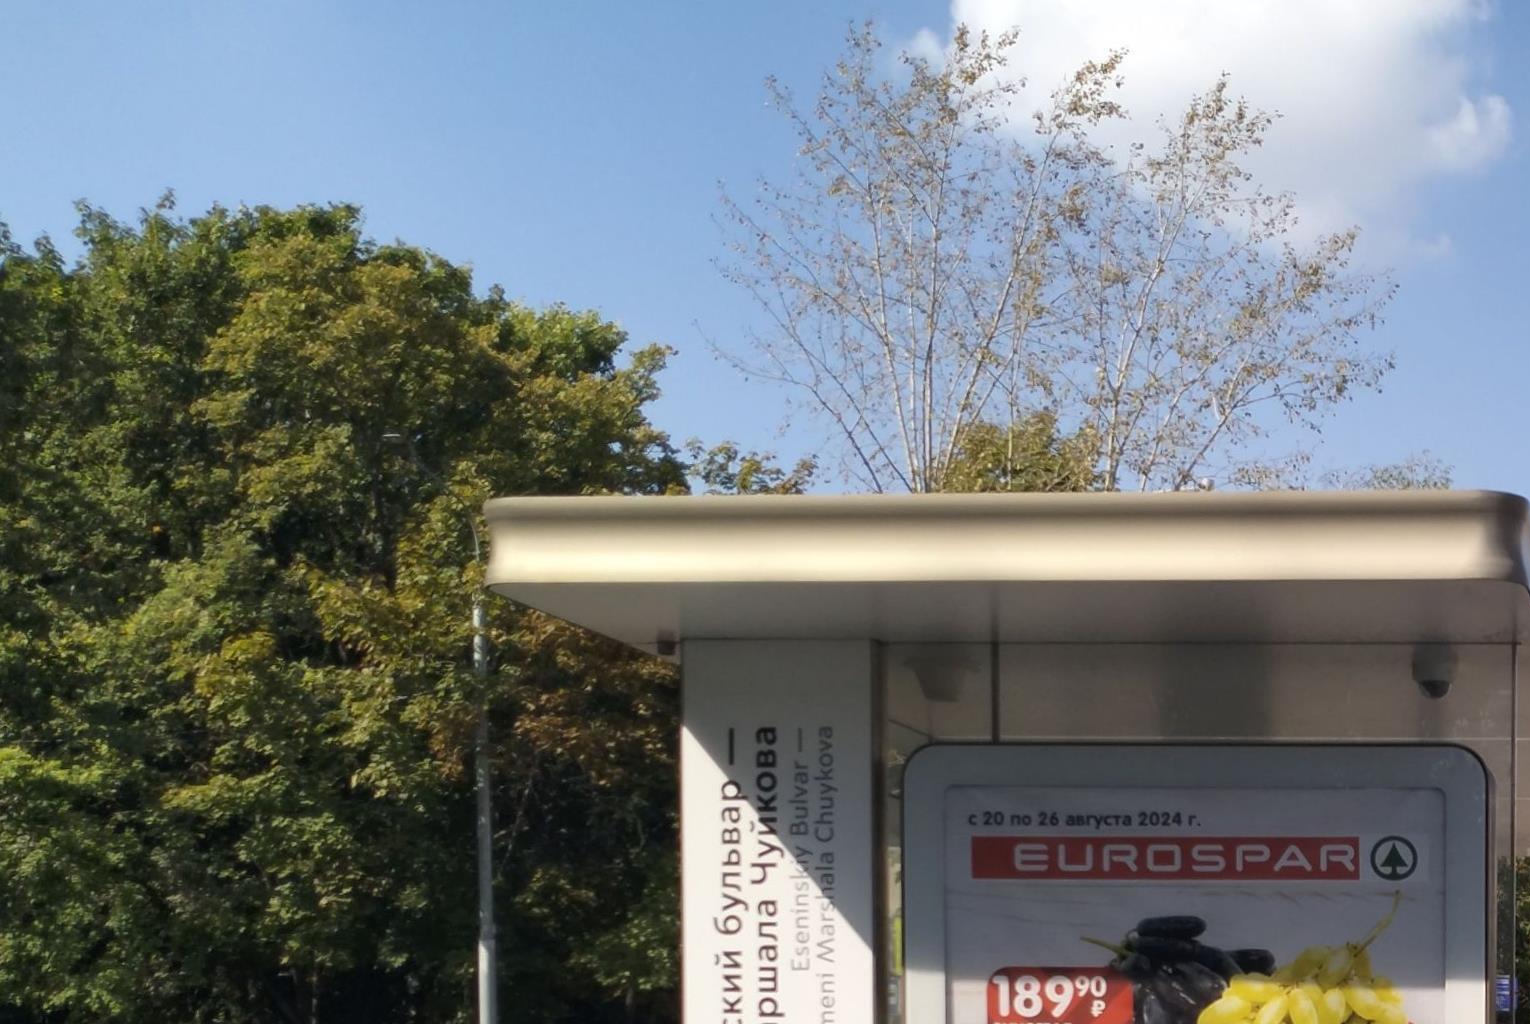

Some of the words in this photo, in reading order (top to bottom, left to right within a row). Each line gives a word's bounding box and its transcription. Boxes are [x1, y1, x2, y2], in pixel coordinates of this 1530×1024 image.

[749, 726, 784, 885] Чуйкова
[789, 761, 810, 834] Bulvar
[814, 726, 838, 842] Chuykova
[983, 811, 1004, 826] 20
[1010, 815, 1032, 826] по
[1038, 811, 1059, 826] 26
[1066, 814, 1132, 829] августа
[1138, 811, 1182, 827] 2024
[1188, 814, 1202, 827] г.
[714, 779, 748, 935] бульвар
[790, 846, 813, 971] Eseninskiy
[815, 852, 837, 963] Marshala
[1013, 842, 1357, 873] EUROSPAR
